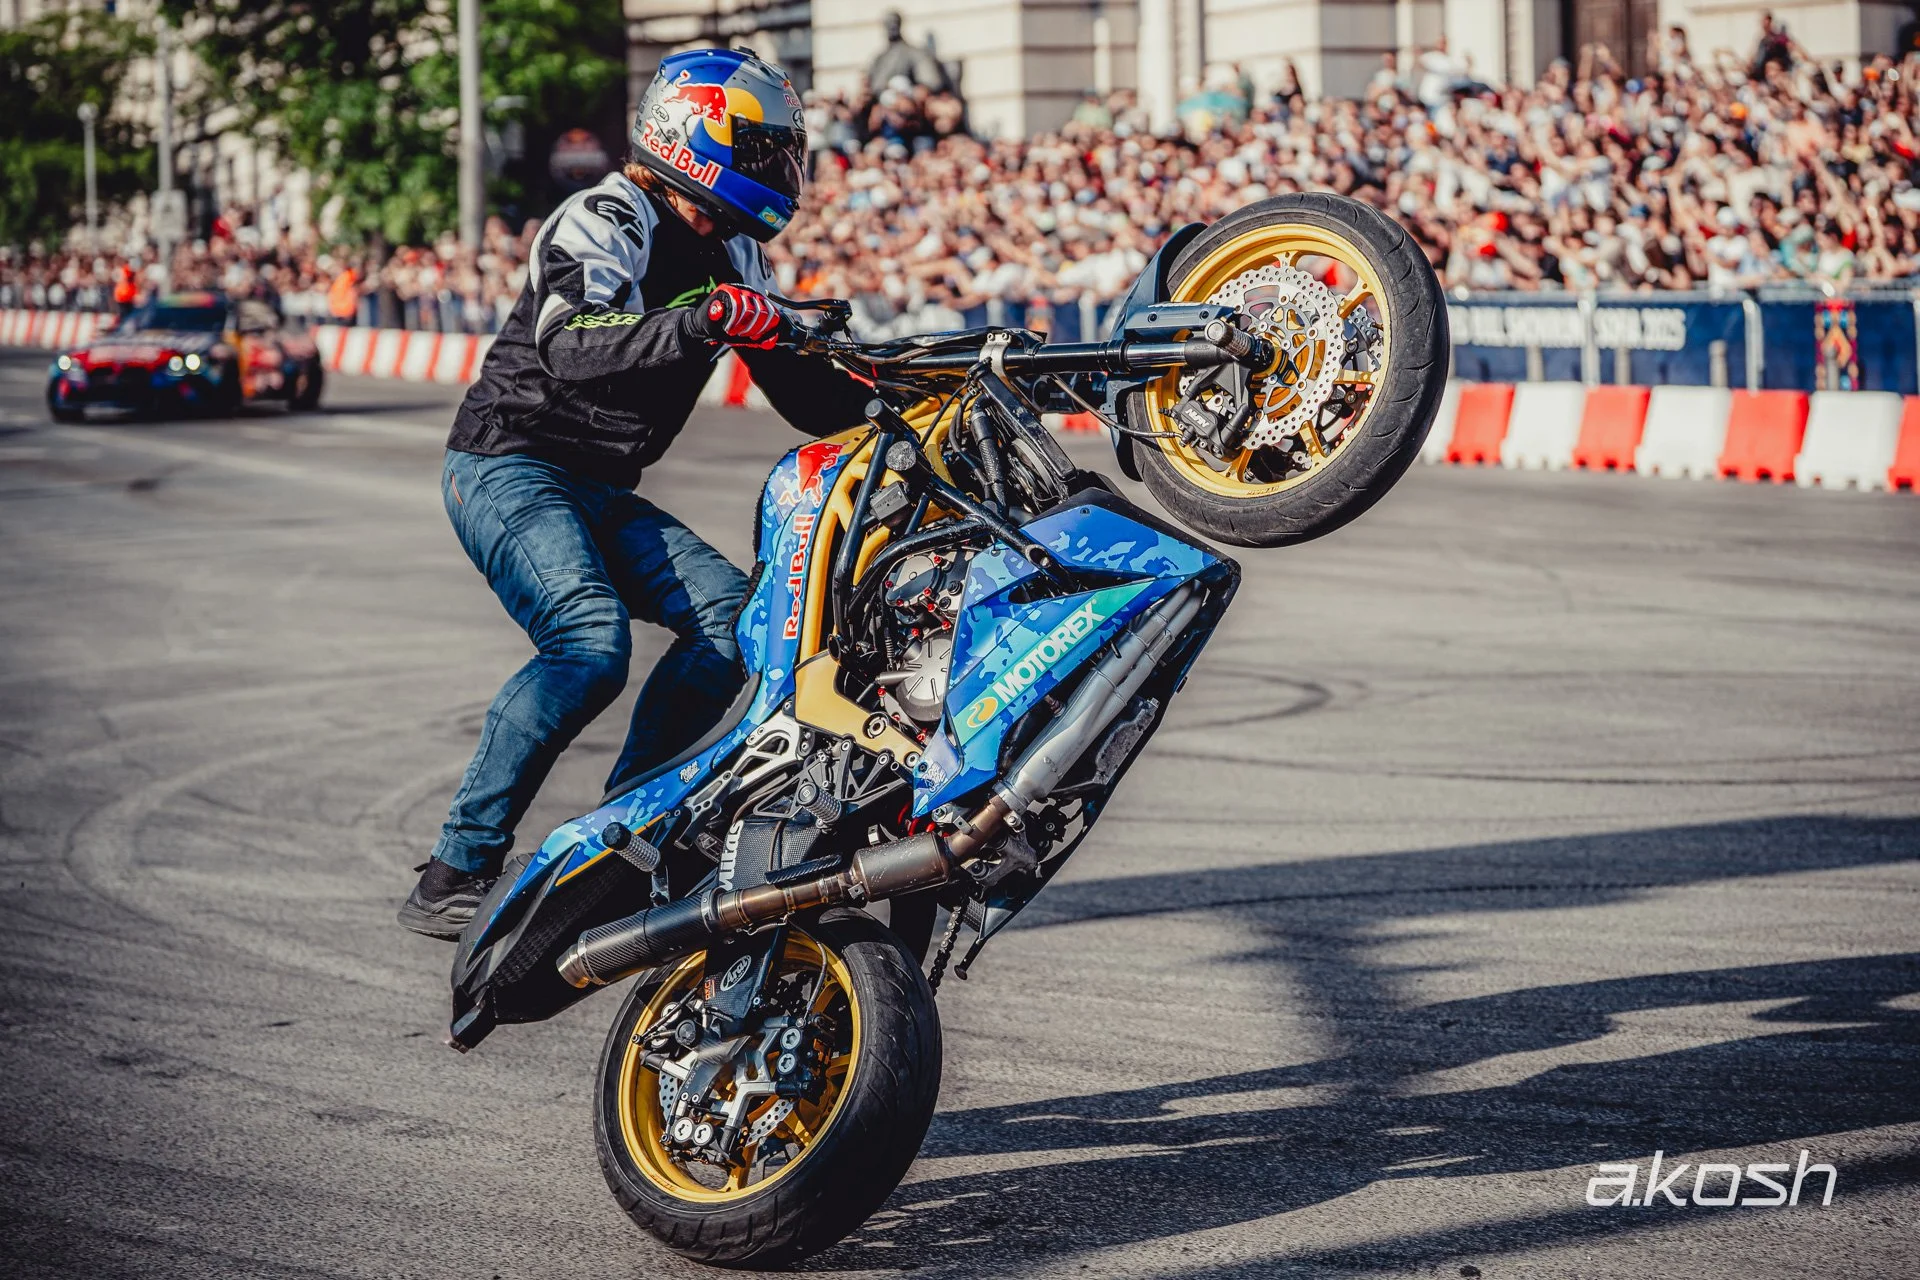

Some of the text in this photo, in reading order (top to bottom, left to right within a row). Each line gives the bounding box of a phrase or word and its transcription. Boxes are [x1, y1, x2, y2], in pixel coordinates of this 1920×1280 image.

[640, 121, 723, 188] Red Bull
[783, 513, 816, 640] Red Bull
[992, 602, 1106, 704] MOTOREX
